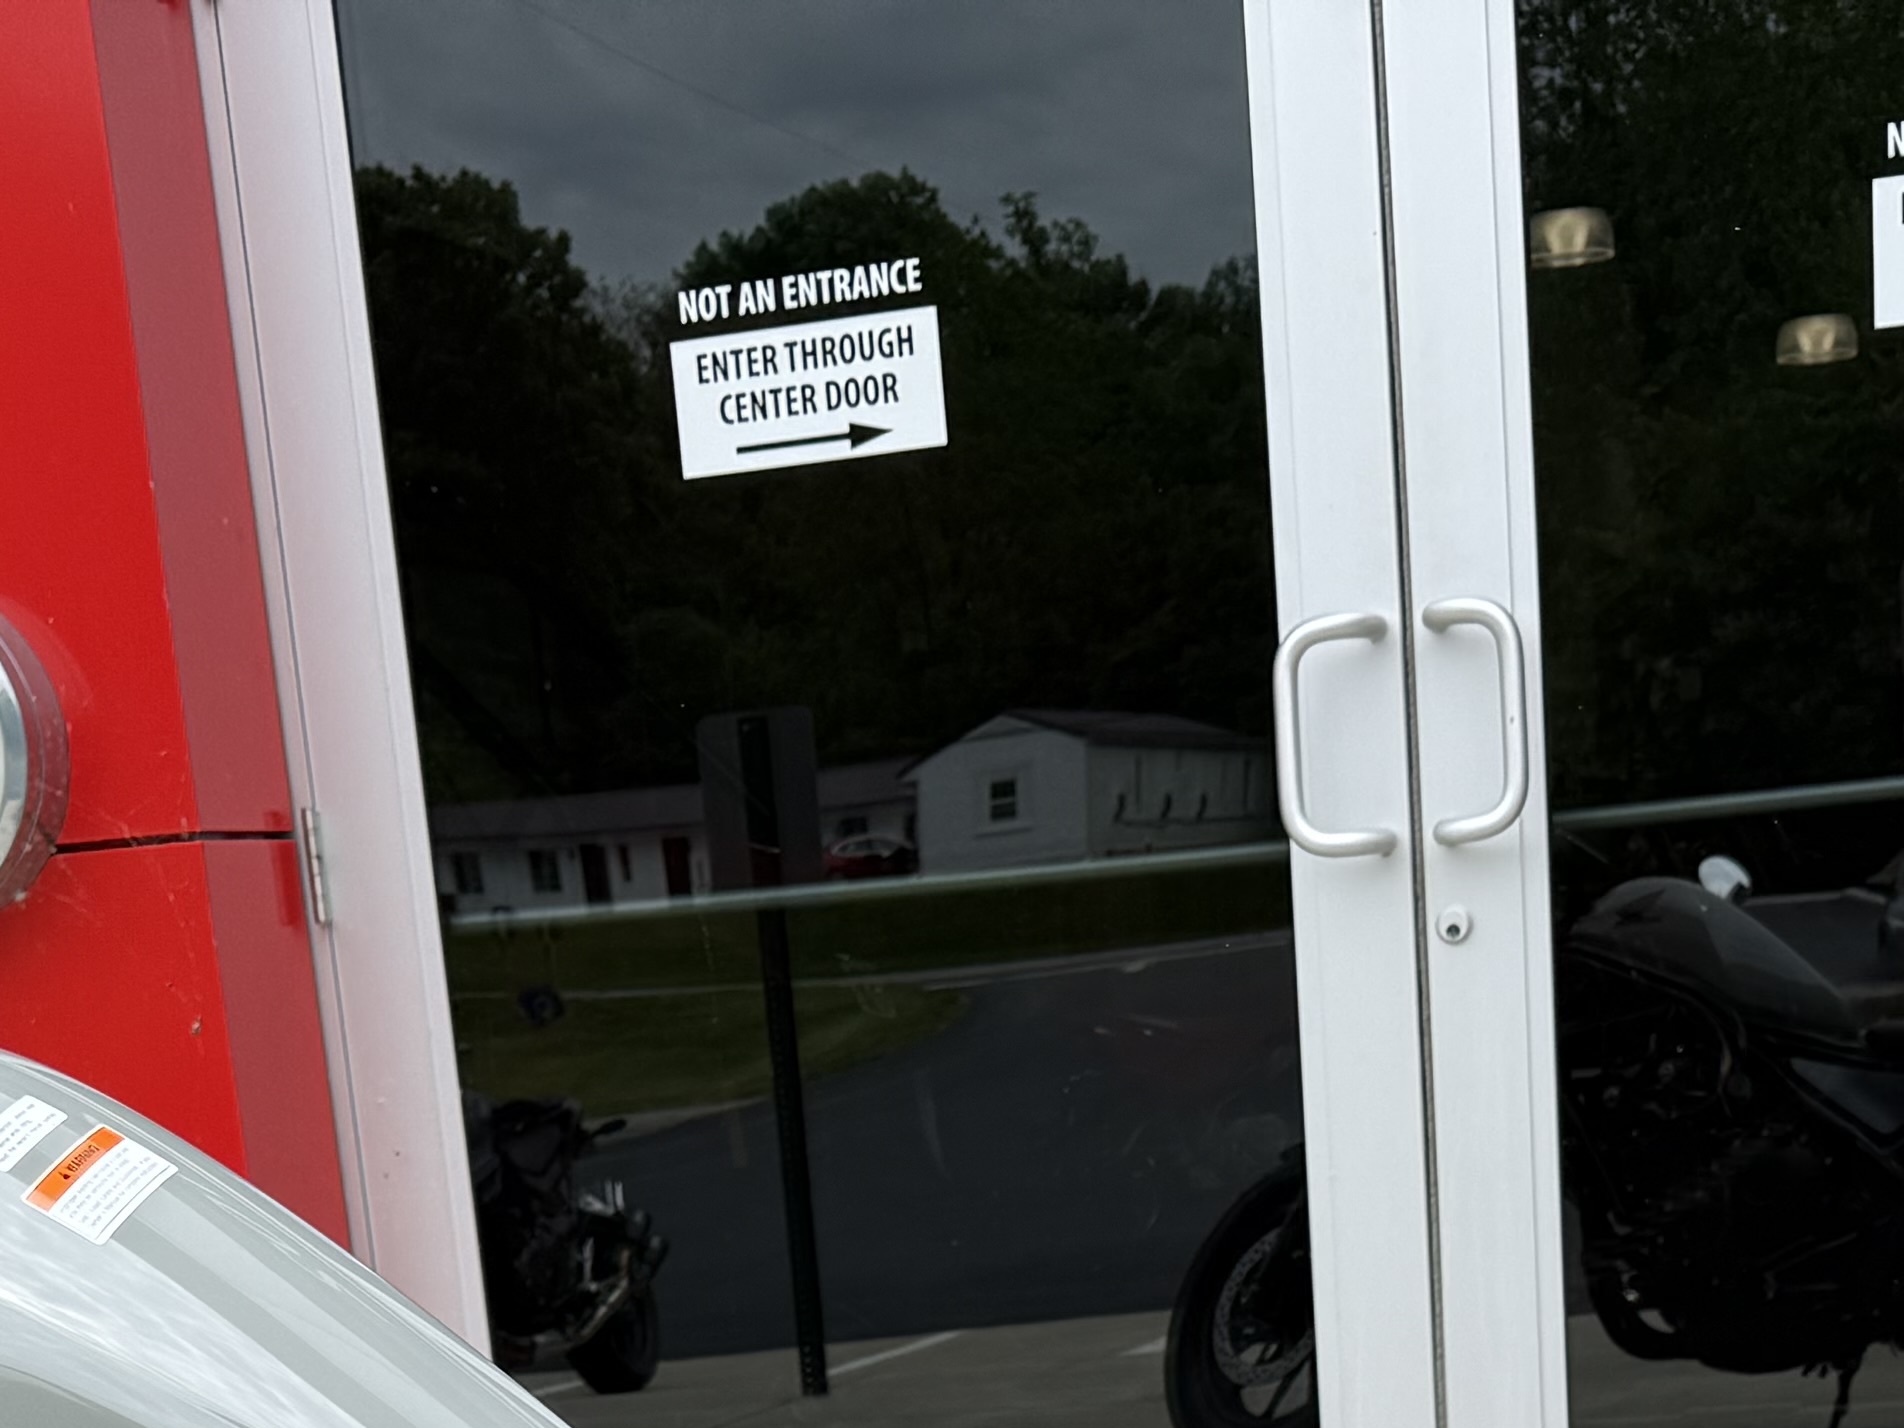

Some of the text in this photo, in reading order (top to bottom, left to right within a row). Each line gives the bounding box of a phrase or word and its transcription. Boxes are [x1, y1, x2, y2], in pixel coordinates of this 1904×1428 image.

[678, 257, 923, 325] NOT AN ENTRANCE
[696, 325, 914, 385] ENTER THROUGH
[719, 372, 900, 425] CENTER DOOR
